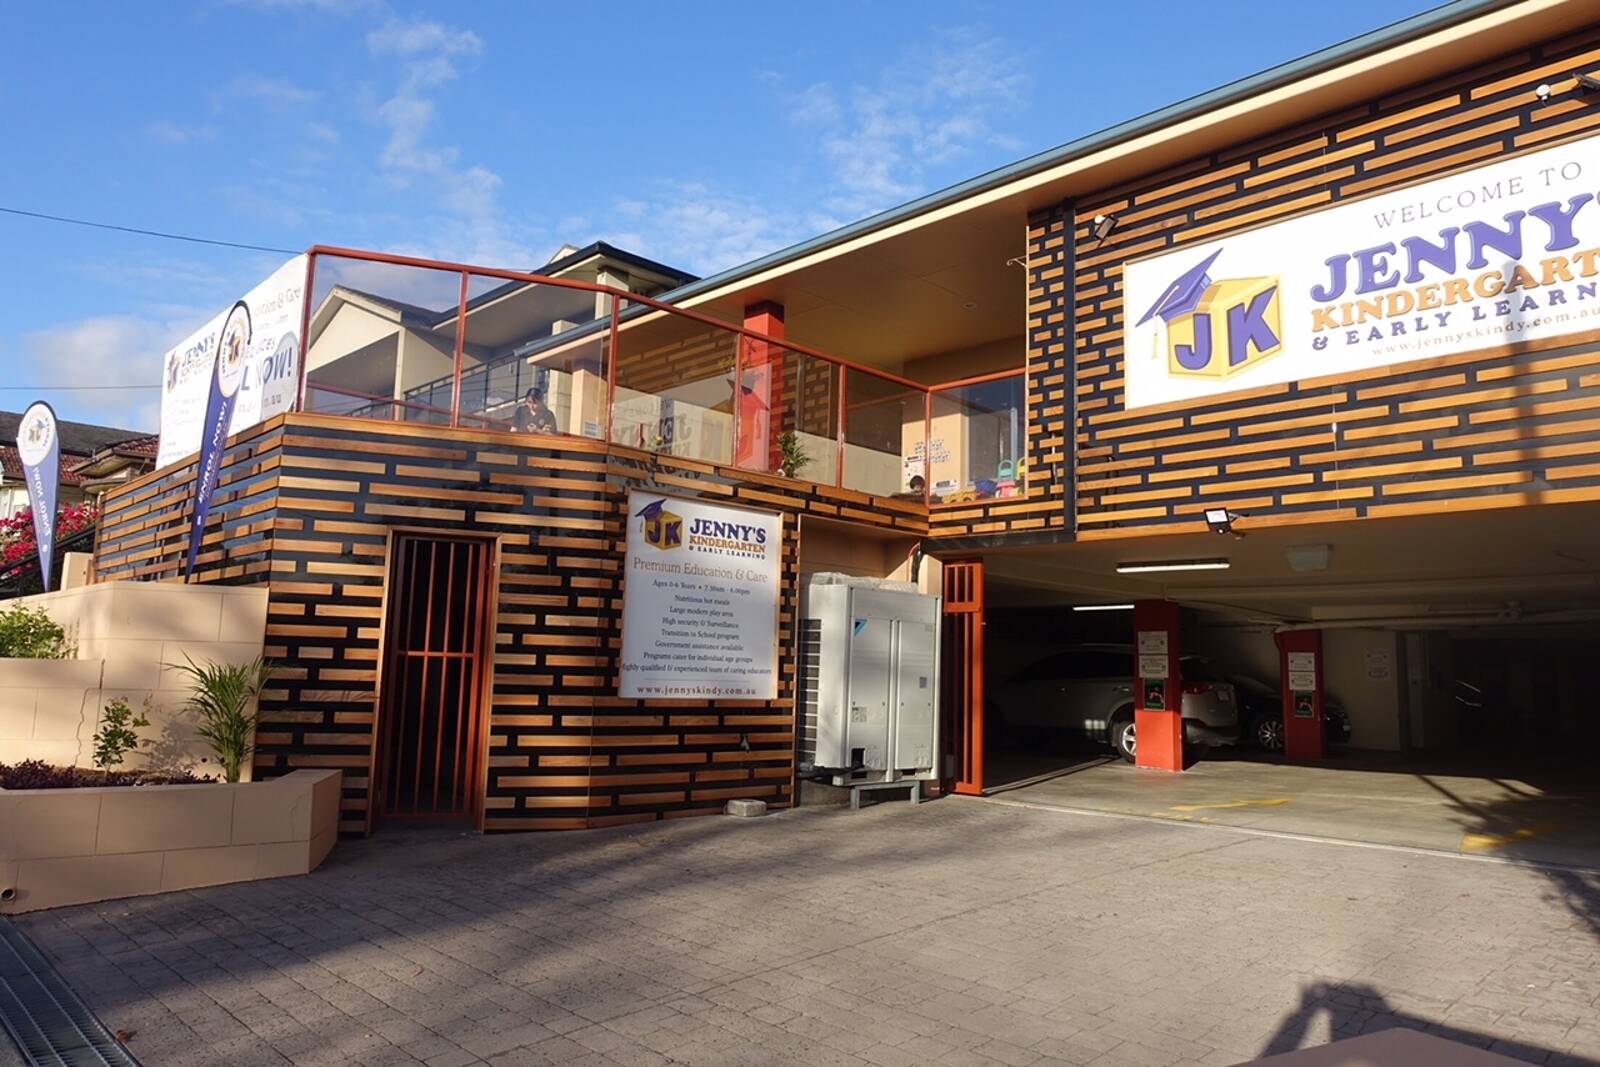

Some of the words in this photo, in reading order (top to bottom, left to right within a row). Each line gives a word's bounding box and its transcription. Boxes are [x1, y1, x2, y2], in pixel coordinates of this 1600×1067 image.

[1373, 175, 1525, 229] WELCOME
[1539, 161, 1583, 187] TO
[1312, 336, 1329, 351] &
[1346, 311, 1451, 345] EARLY
[689, 518, 767, 544] JENNY'S
[689, 535, 766, 553] KINDERGARTEN
[697, 546, 723, 555] EARLY
[726, 550, 766, 560] LEARNING
[633, 557, 681, 574] Premium
[683, 562, 733, 580] Education
[734, 568, 745, 580] &
[746, 570, 768, 583] Care
[652, 579, 668, 589] Ages
[680, 582, 696, 591] Years
[703, 597, 713, 605] hot
[714, 598, 730, 606] meals
[669, 606, 686, 615] Large
[687, 607, 708, 616] modern
[709, 608, 721, 618] play
[721, 610, 734, 618] area
[662, 617, 677, 627] High
[677, 618, 699, 628] security
[707, 620, 740, 630] Surveillance
[661, 628, 690, 638] Transition
[690, 630, 697, 638] to
[697, 630, 717, 639] School
[716, 632, 740, 642] program
[654, 641, 691, 651] Government
[691, 642, 720, 652] assistance
[720, 643, 744, 652] available
[643, 651, 672, 662] Programs
[672, 653, 687, 662] cater
[687, 653, 696, 662] for
[696, 654, 724, 663] individual
[724, 655, 735, 665] age
[735, 656, 753, 666] groups
[640, 663, 667, 673] qualified
[673, 664, 708, 674] experienced
[708, 666, 723, 674] team
[730, 667, 747, 676] caring
[746, 668, 772, 676] educators
[636, 685, 757, 697] www.jennyskindy.com.au
